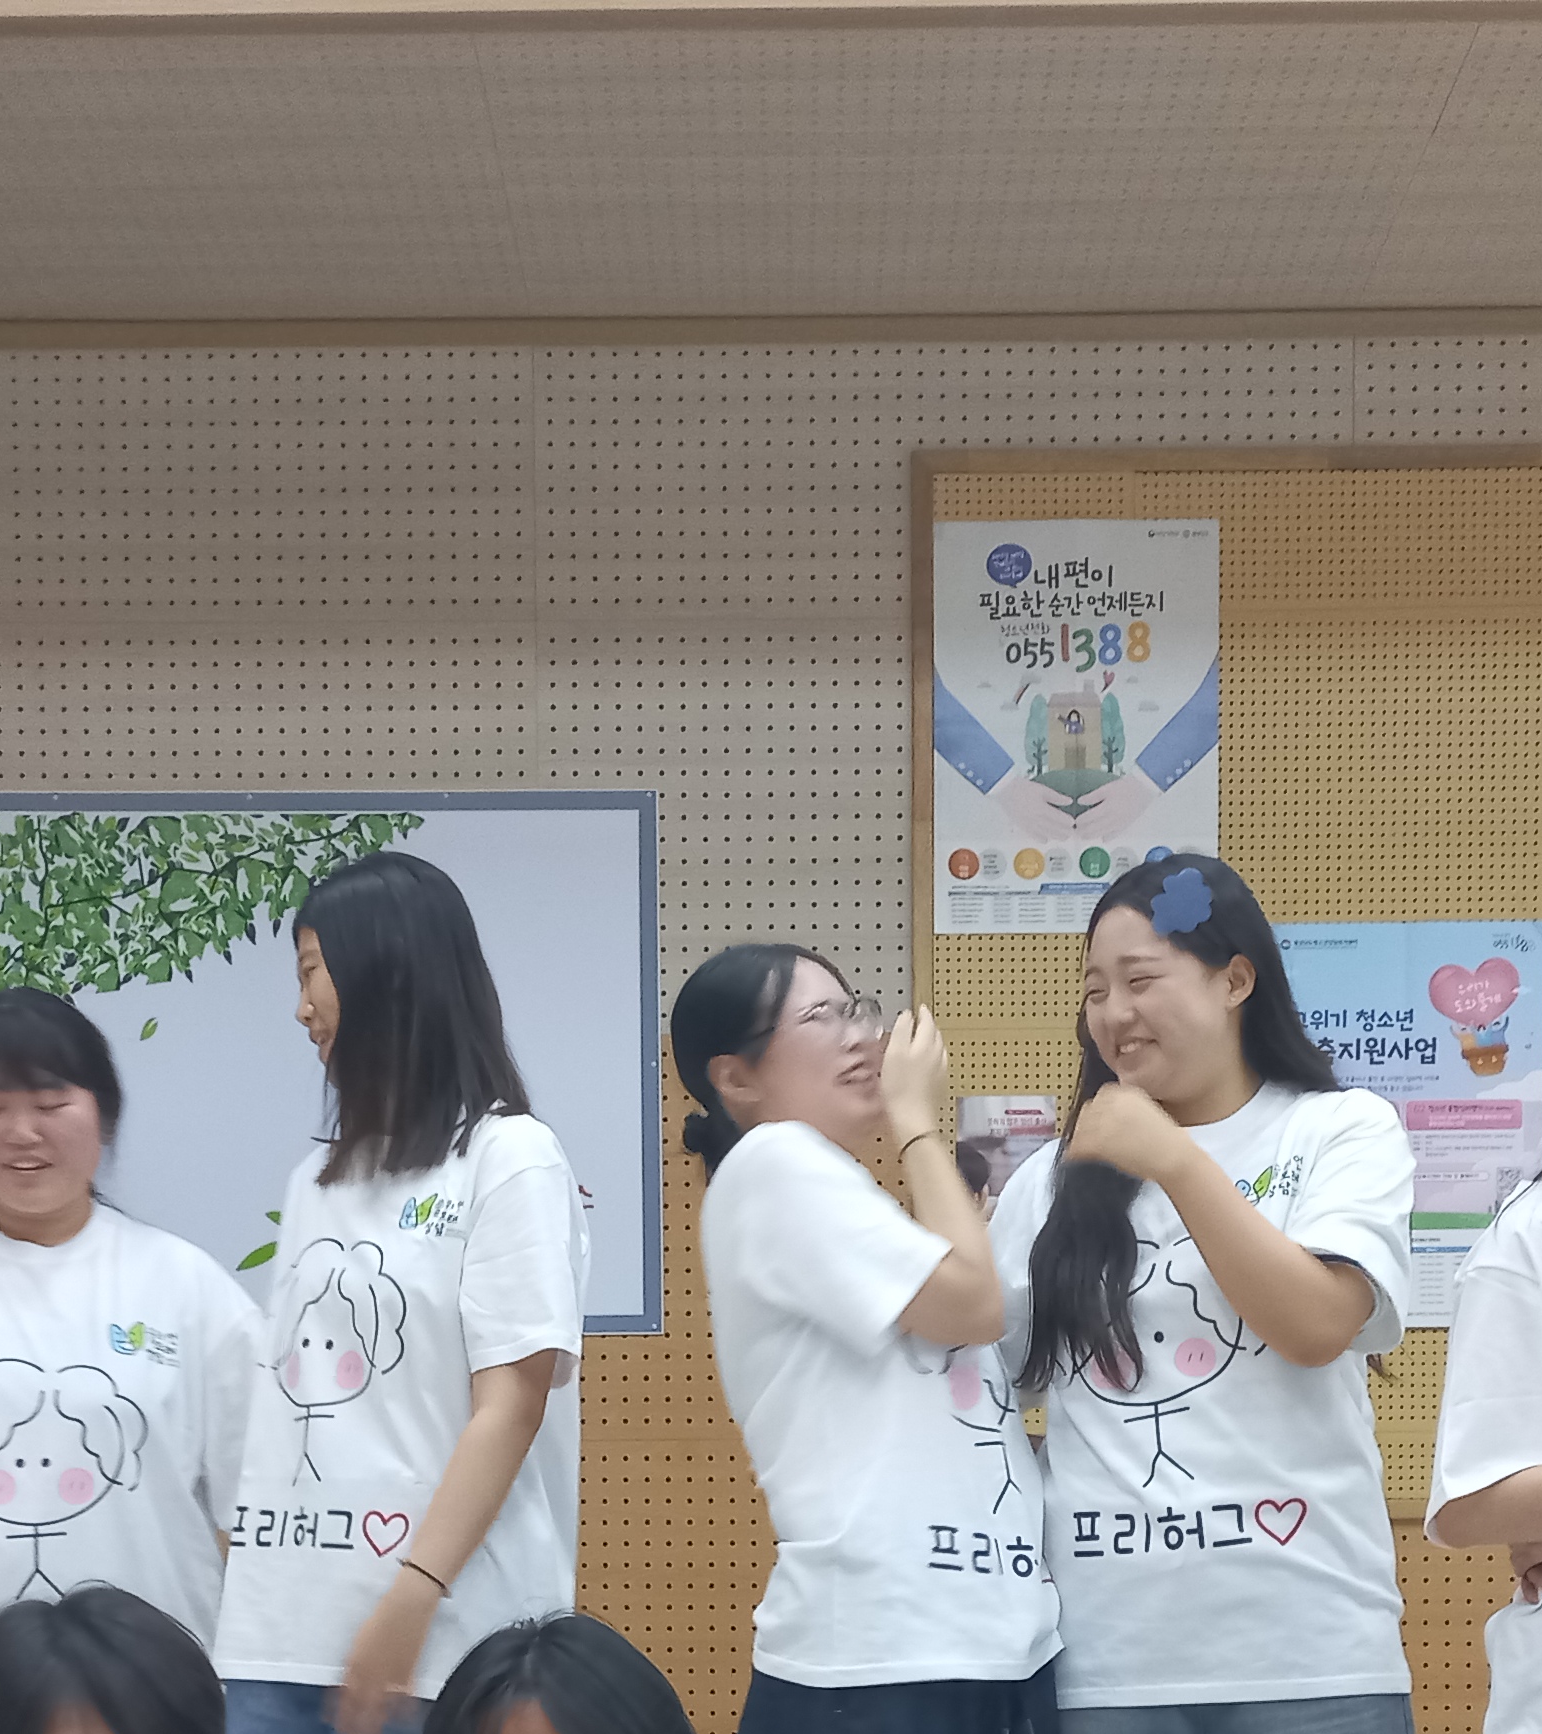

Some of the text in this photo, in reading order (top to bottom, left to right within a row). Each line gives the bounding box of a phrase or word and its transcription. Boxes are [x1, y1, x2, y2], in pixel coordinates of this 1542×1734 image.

[1033, 562, 1060, 589] 내
[1063, 556, 1114, 589] 편이
[978, 590, 1165, 621] 필요한 순간 언제든지
[1355, 1008, 1414, 1032] 청소년
[1073, 1506, 1254, 1558] 프리허그
